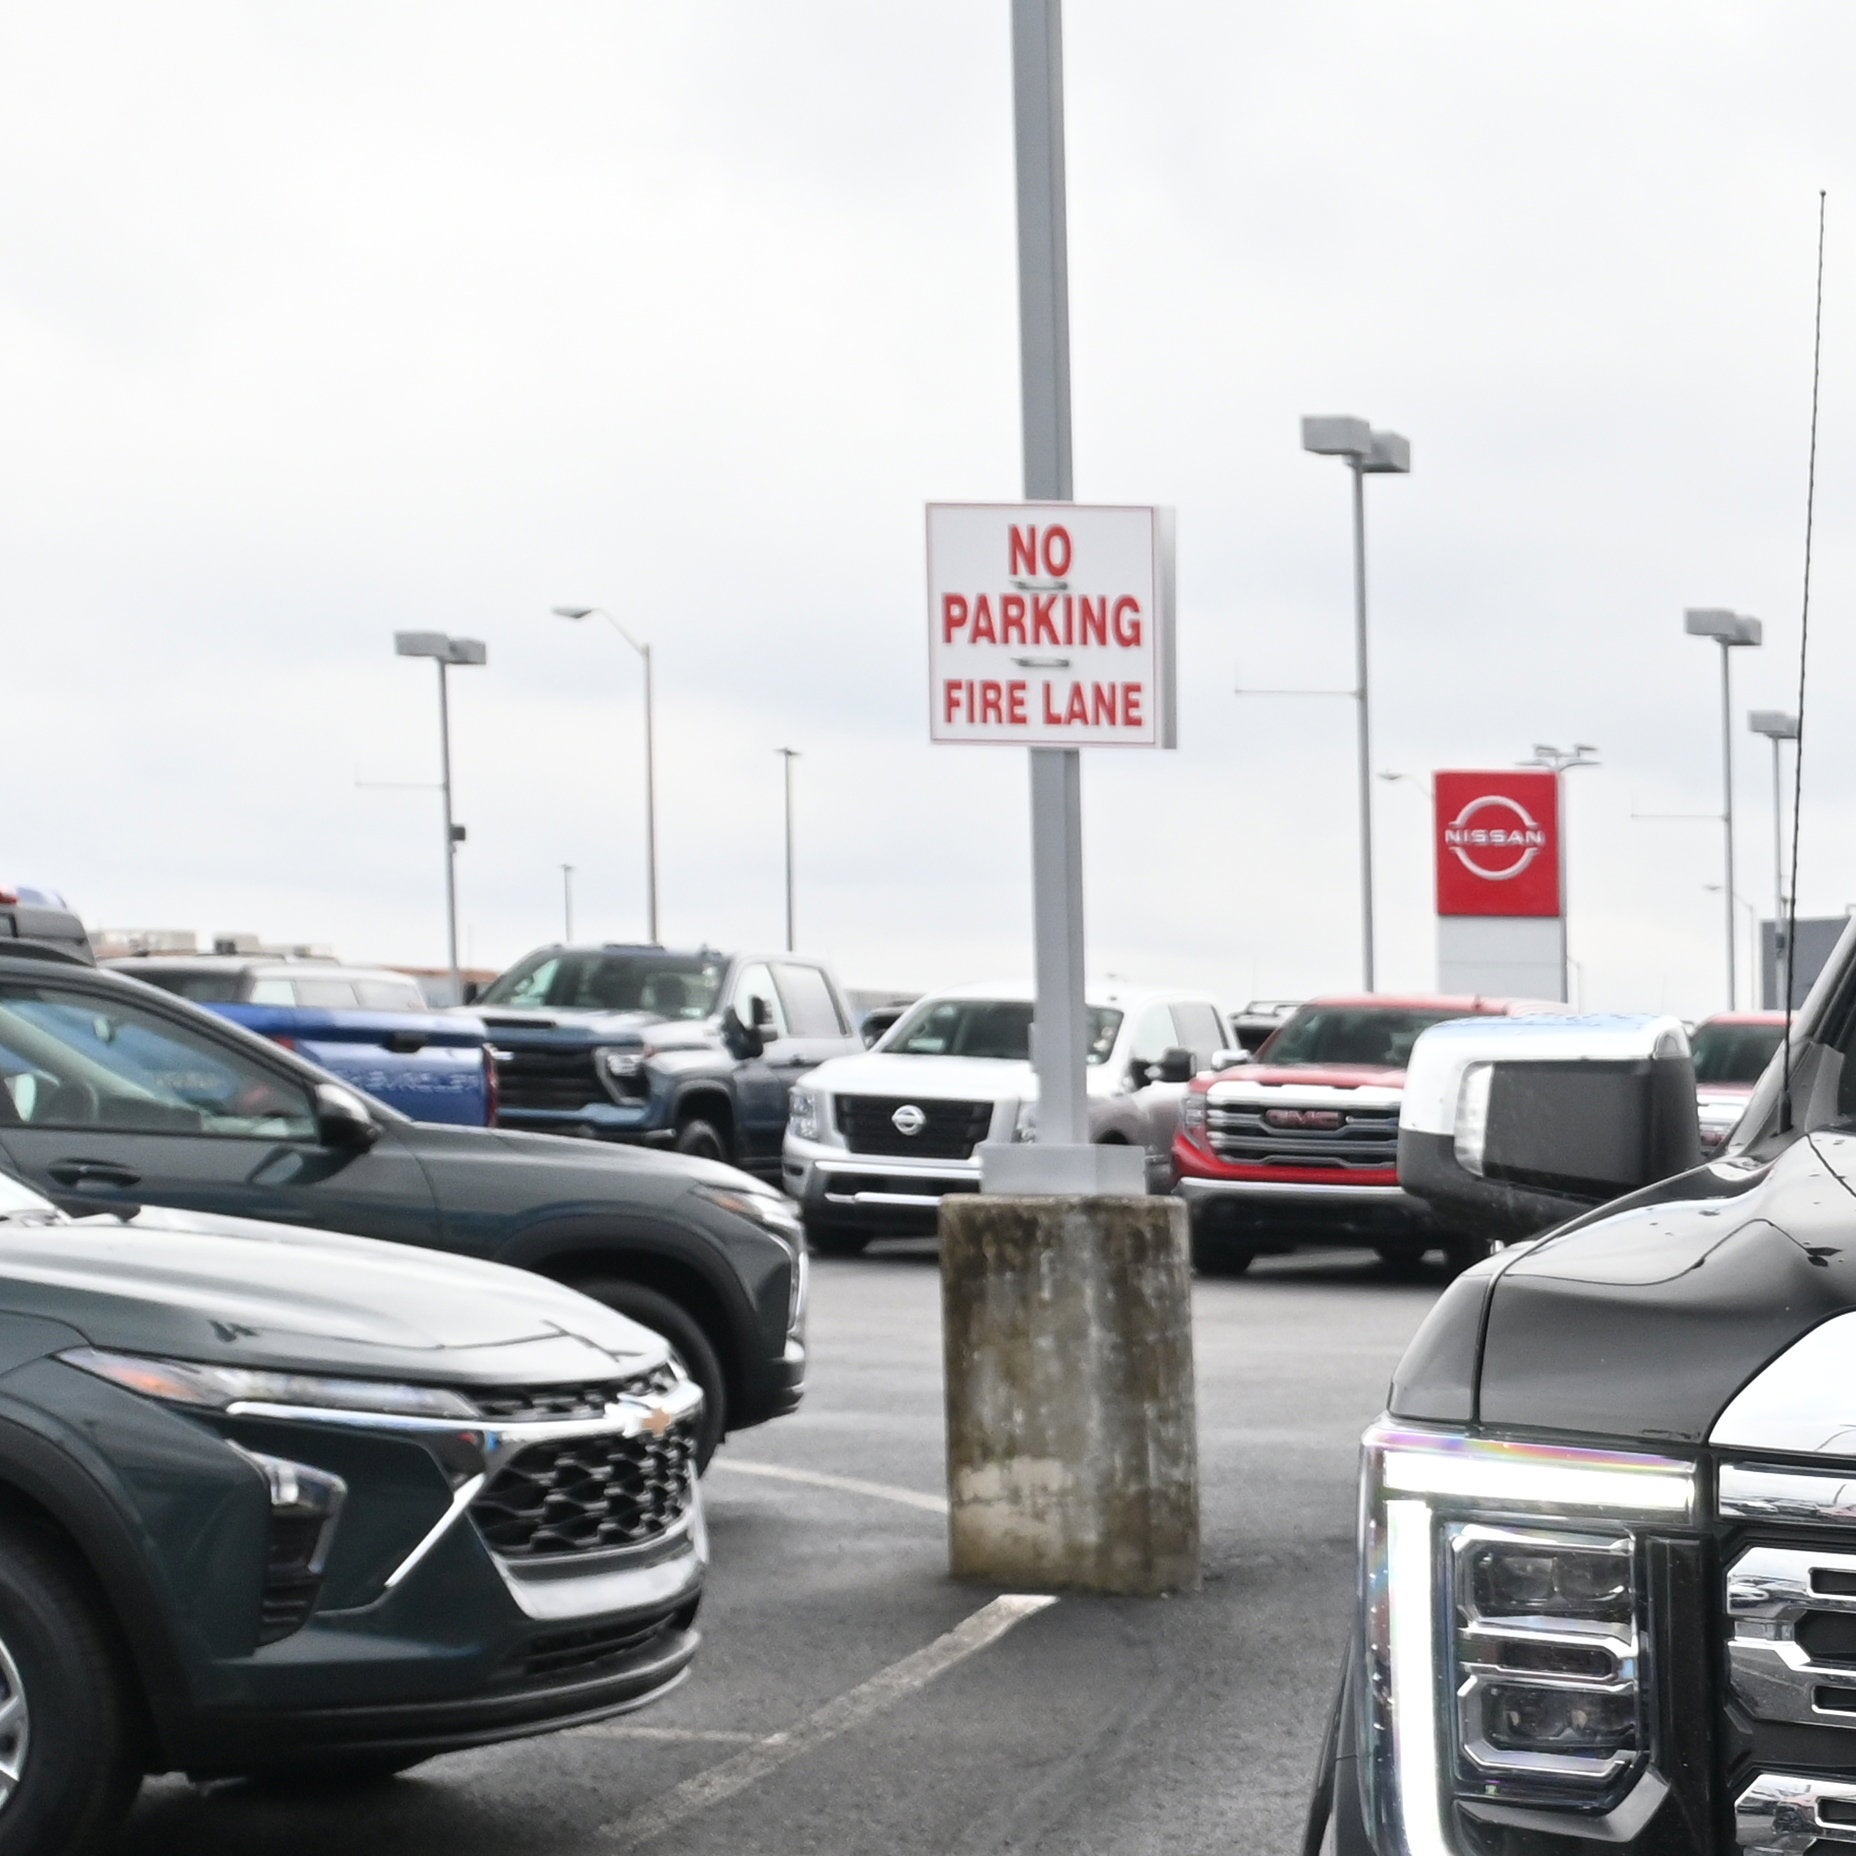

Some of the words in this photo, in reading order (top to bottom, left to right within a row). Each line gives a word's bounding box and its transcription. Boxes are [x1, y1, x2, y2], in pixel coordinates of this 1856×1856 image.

[1008, 524, 1073, 577] NO
[941, 592, 1142, 647] PARKING
[943, 679, 1028, 724] FIRE
[1042, 680, 1143, 726] LANE
[1445, 829, 1545, 846] NISSAN
[1265, 1109, 1339, 1128] GMC
